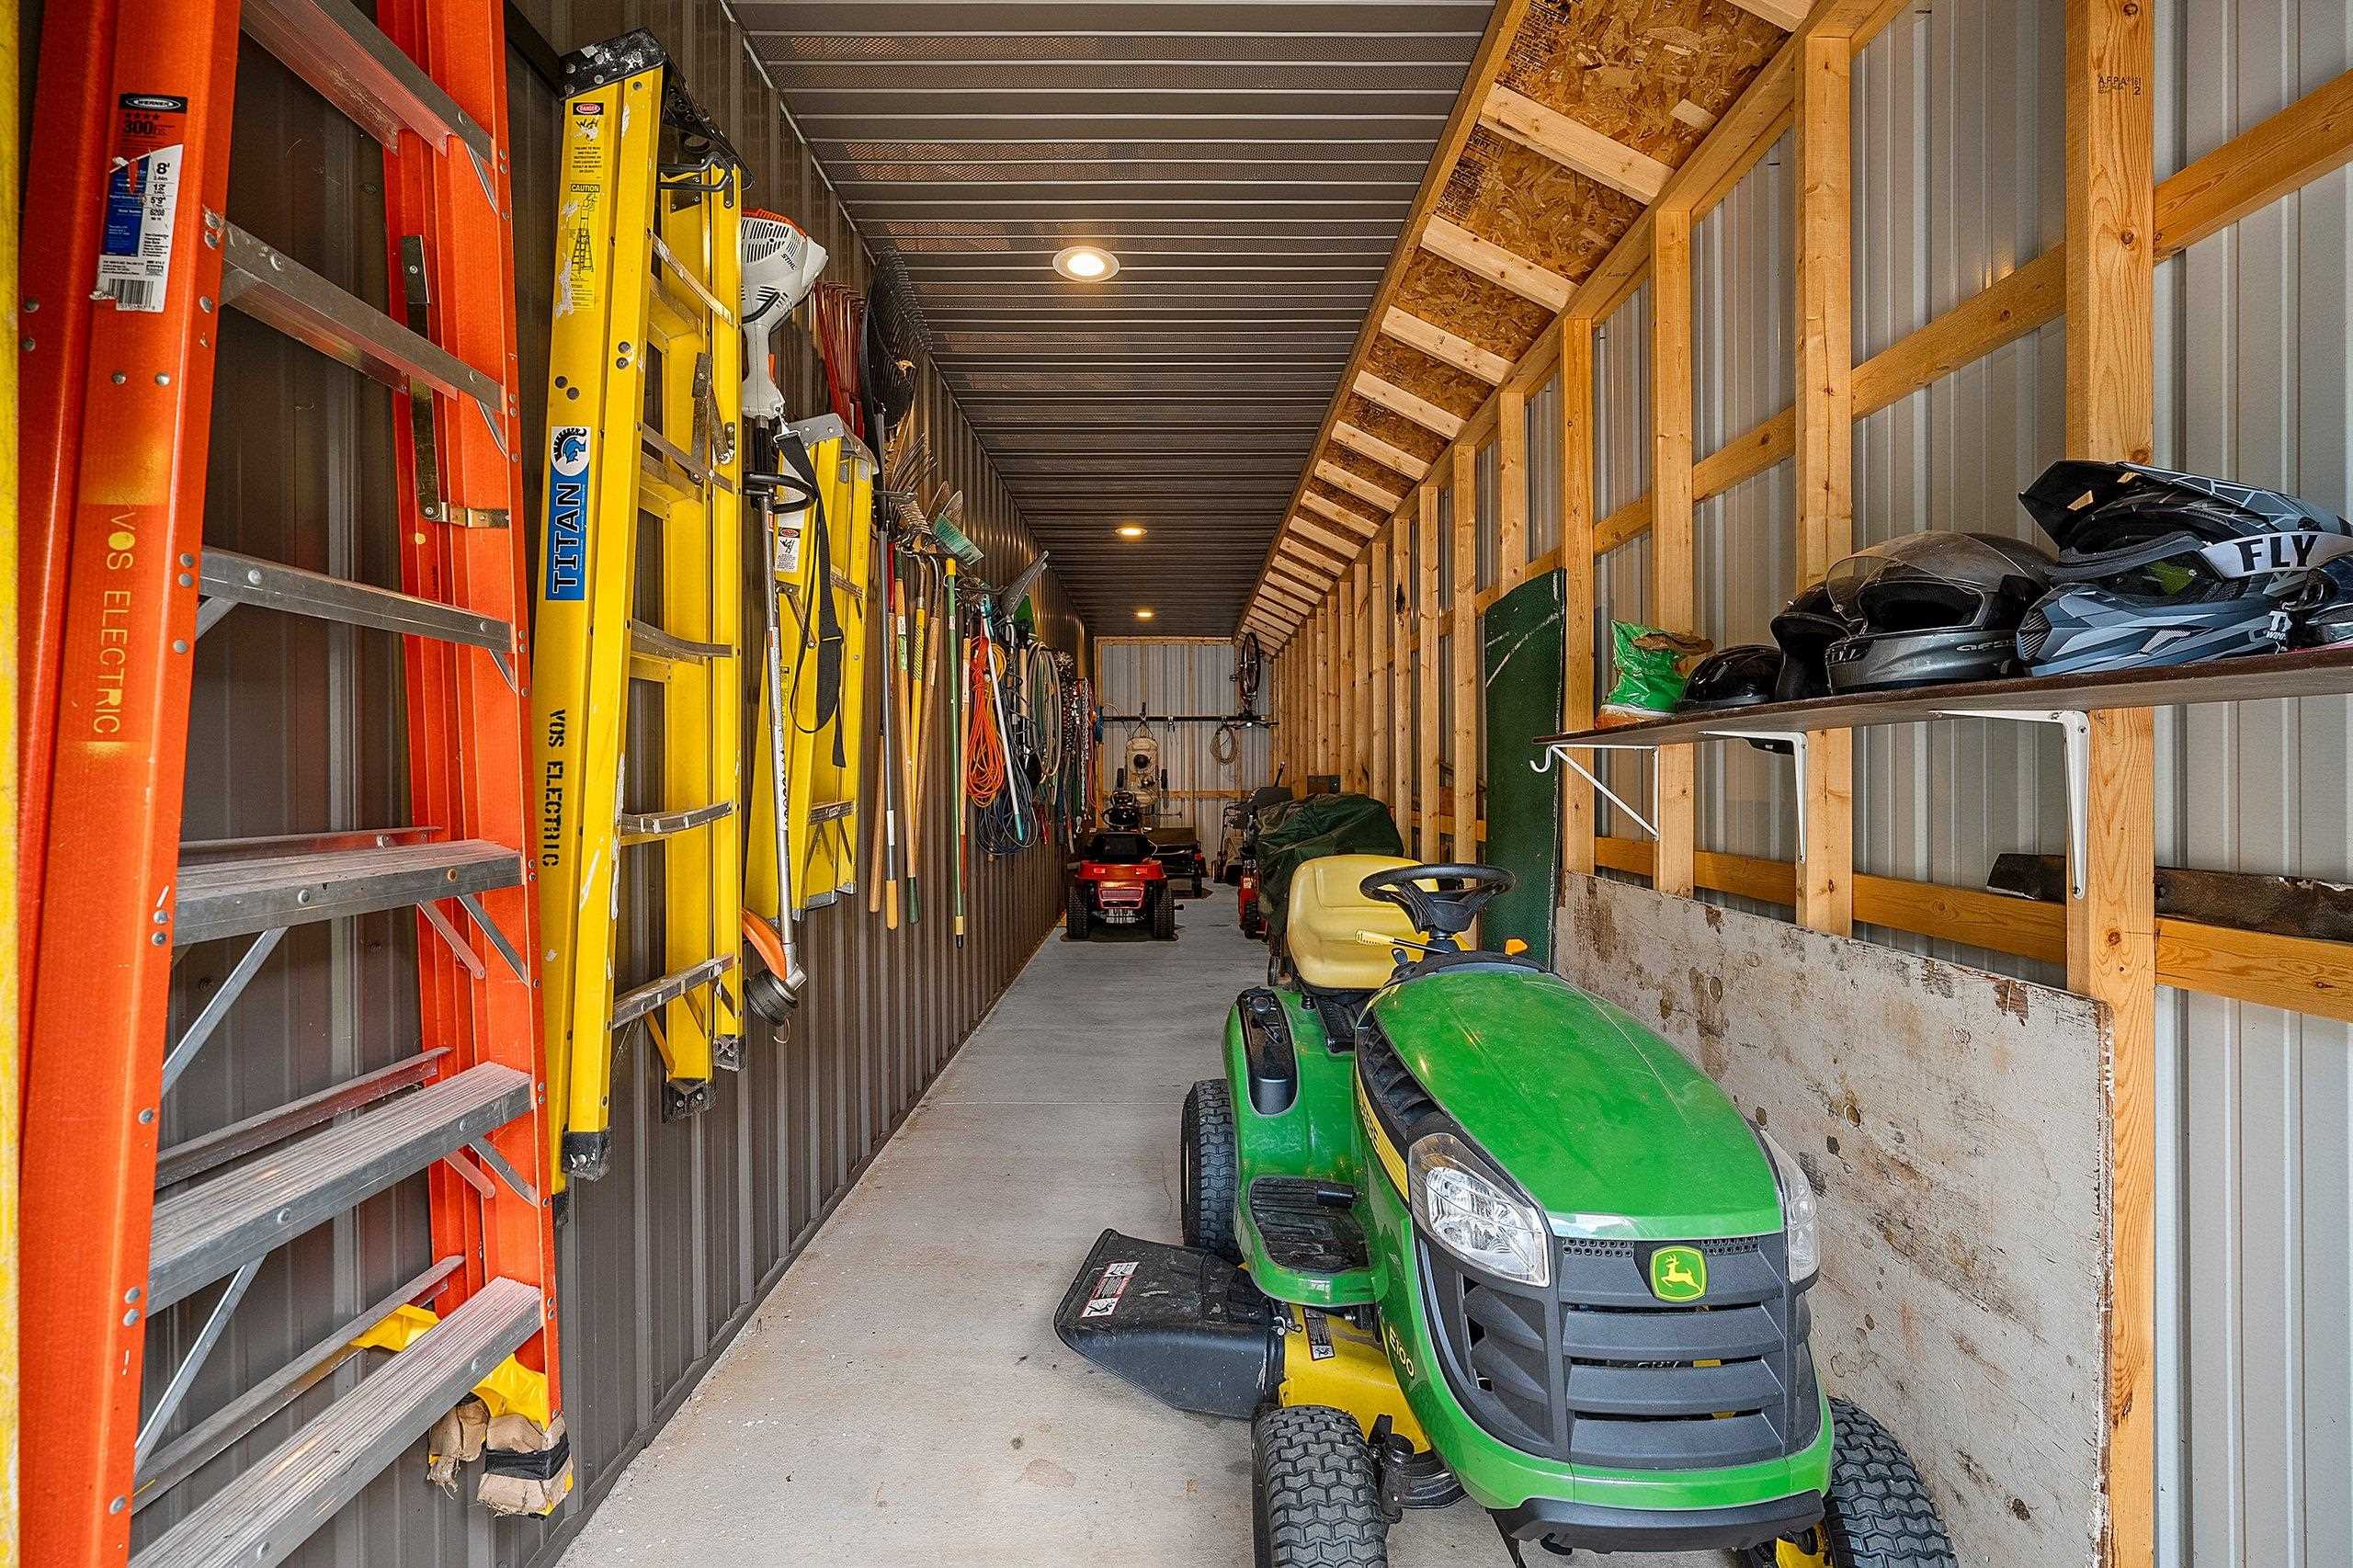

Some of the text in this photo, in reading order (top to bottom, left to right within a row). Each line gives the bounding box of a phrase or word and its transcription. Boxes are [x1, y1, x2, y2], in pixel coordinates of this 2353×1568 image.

[124, 119, 153, 134] 300
[781, 253, 796, 270] STIHL
[552, 483, 581, 594] TITAN
[2234, 534, 2318, 572] FLY
[93, 512, 136, 733] VOS ELECTRIC
[542, 709, 565, 867] VOS ELECTRIC
[1389, 1325, 1415, 1378] E100
